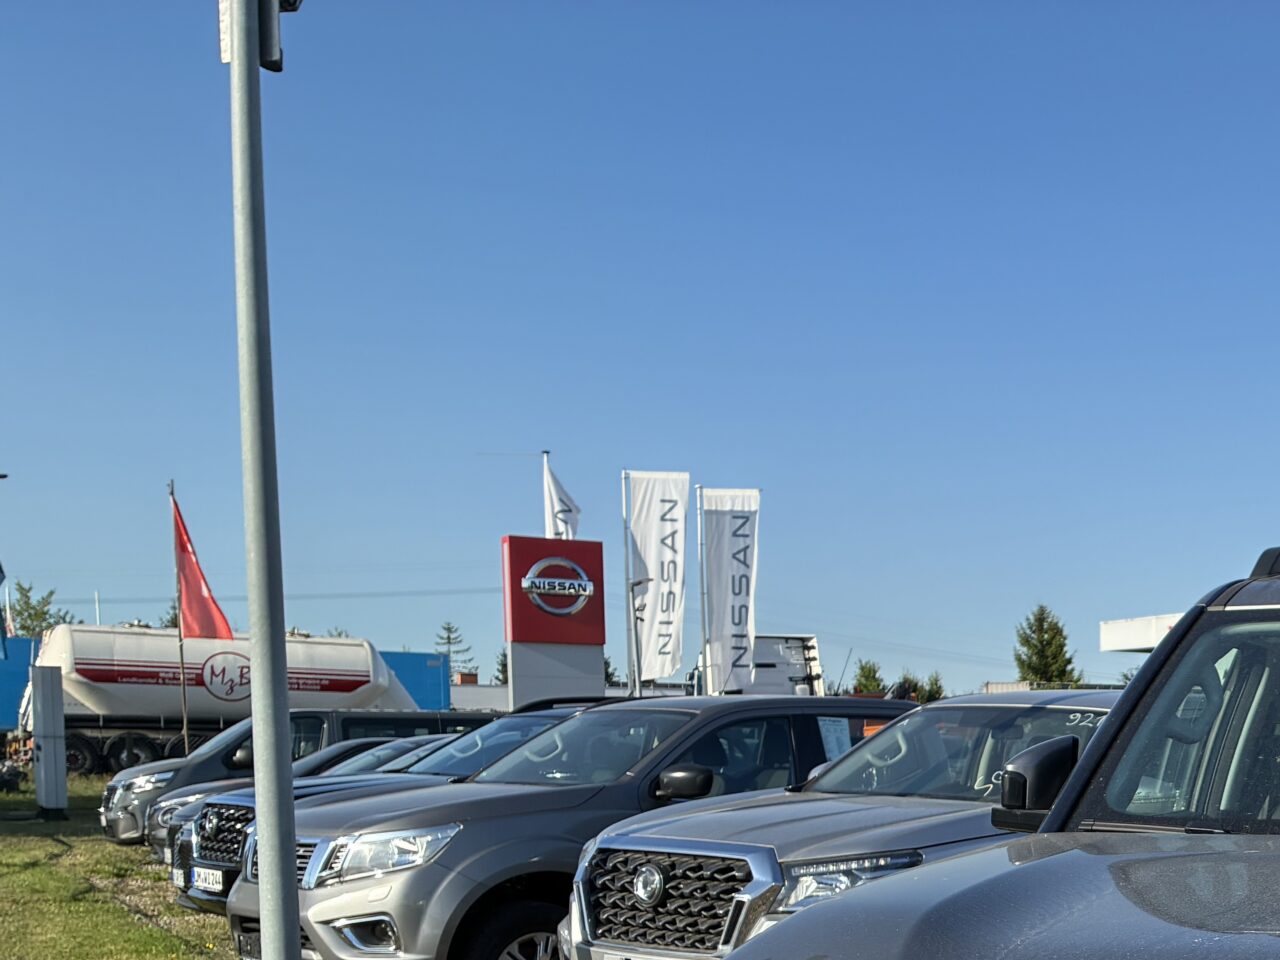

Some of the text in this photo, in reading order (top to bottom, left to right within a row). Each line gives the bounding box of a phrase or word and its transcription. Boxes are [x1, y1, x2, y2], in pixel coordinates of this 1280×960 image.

[530, 580, 587, 592] NISSAN
[658, 498, 679, 656] NISSAN
[731, 515, 751, 669] NISSAN
